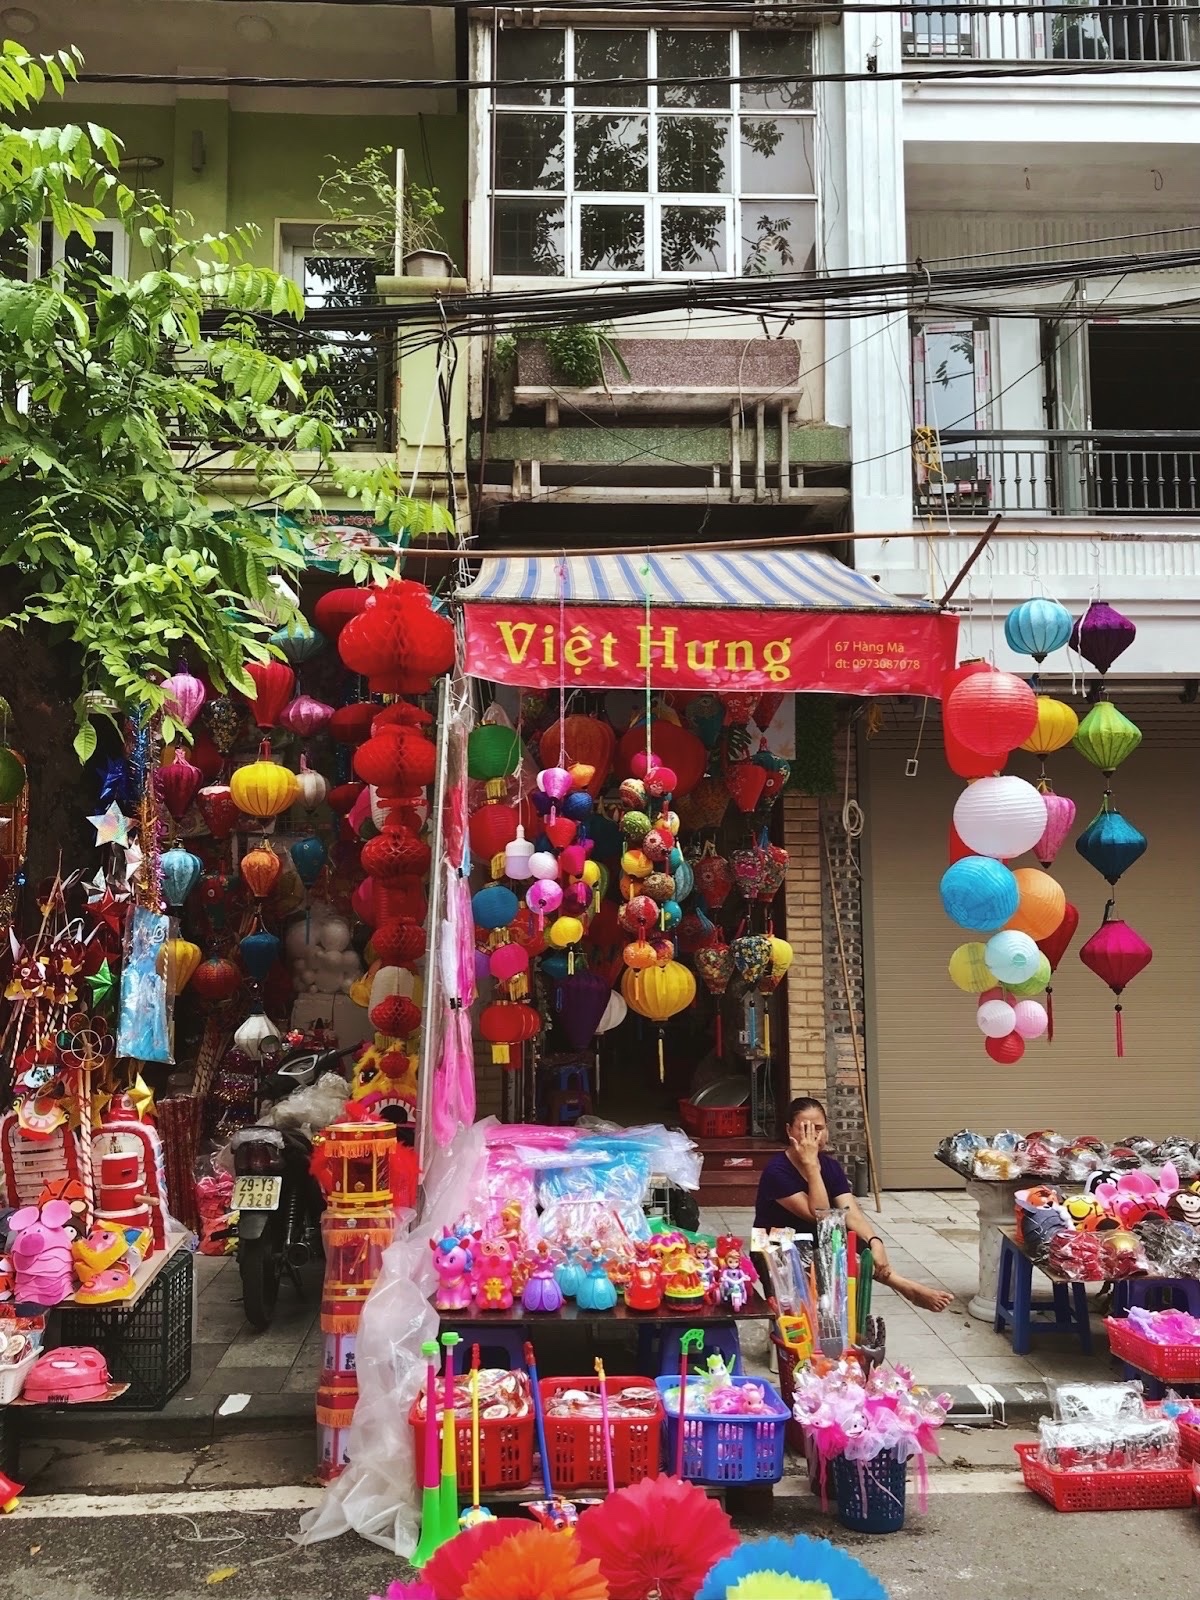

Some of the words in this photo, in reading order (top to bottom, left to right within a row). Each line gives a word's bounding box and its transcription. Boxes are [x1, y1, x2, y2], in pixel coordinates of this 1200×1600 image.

[496, 621, 619, 676] Việt
[636, 626, 792, 682] Hưng
[835, 641, 850, 652] 67
[853, 641, 884, 655] Hàng
[887, 642, 904, 653] Mã
[852, 659, 920, 670] 0973087078
[238, 1193, 272, 1207] 7328
